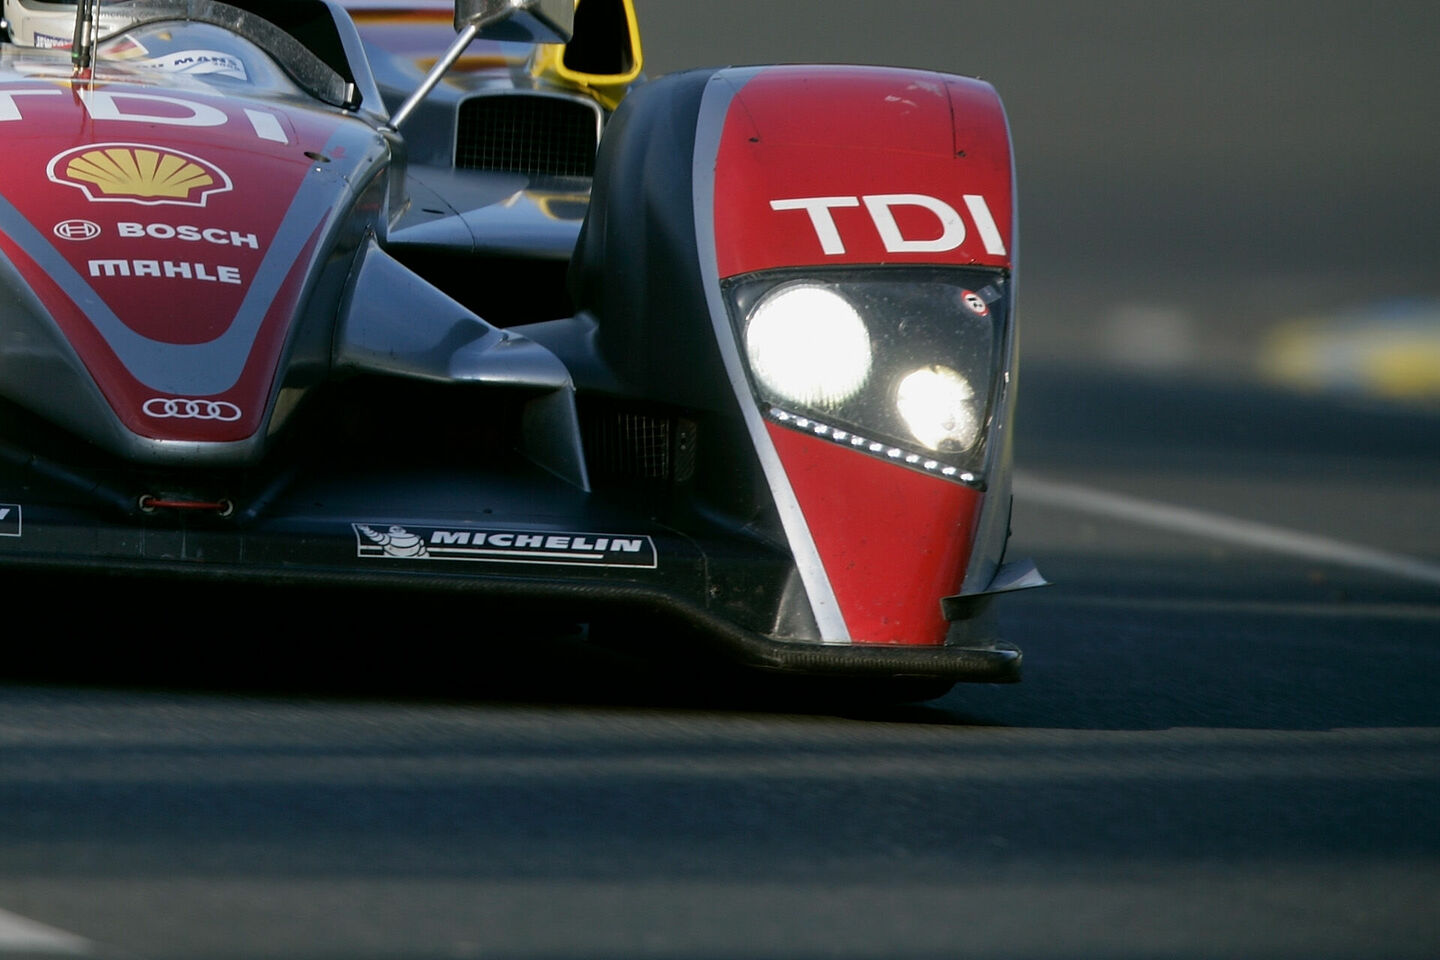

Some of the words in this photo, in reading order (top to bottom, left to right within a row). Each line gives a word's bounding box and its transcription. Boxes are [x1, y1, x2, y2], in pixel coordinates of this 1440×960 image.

[118, 221, 260, 250] BOSCH
[769, 193, 1007, 256] TDI
[88, 259, 242, 285] MAHLE
[430, 530, 643, 553] MICHELIN
